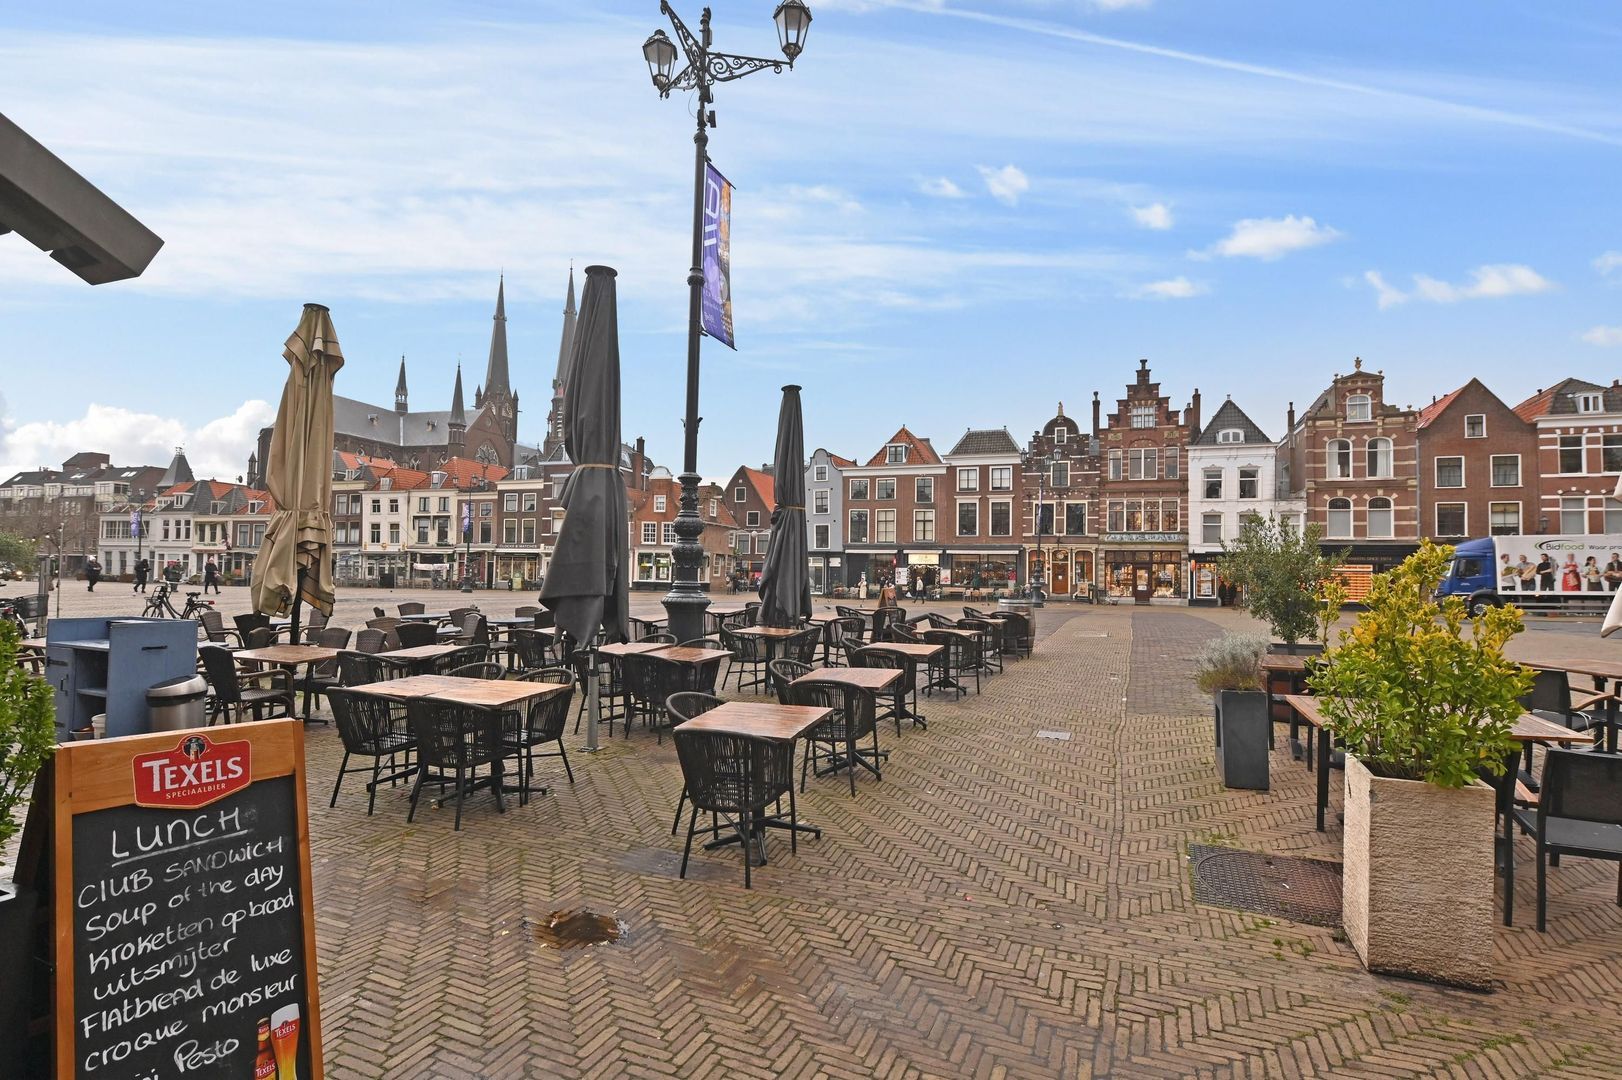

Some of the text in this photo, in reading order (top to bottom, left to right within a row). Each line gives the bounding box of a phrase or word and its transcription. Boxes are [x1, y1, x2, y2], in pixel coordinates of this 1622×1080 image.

[1546, 543, 1584, 551] Bidfood
[142, 756, 243, 793] TEXELS
[166, 783, 226, 800] SPECIAALBIER
[168, 885, 192, 908] of
[198, 879, 237, 898] the
[210, 968, 241, 990] de
[251, 948, 293, 972] luxe
[202, 973, 299, 1023] monsieur
[274, 1023, 297, 1038] TEXELS
[173, 1038, 240, 1073] Pesto
[256, 1062, 276, 1078] TEXELS
